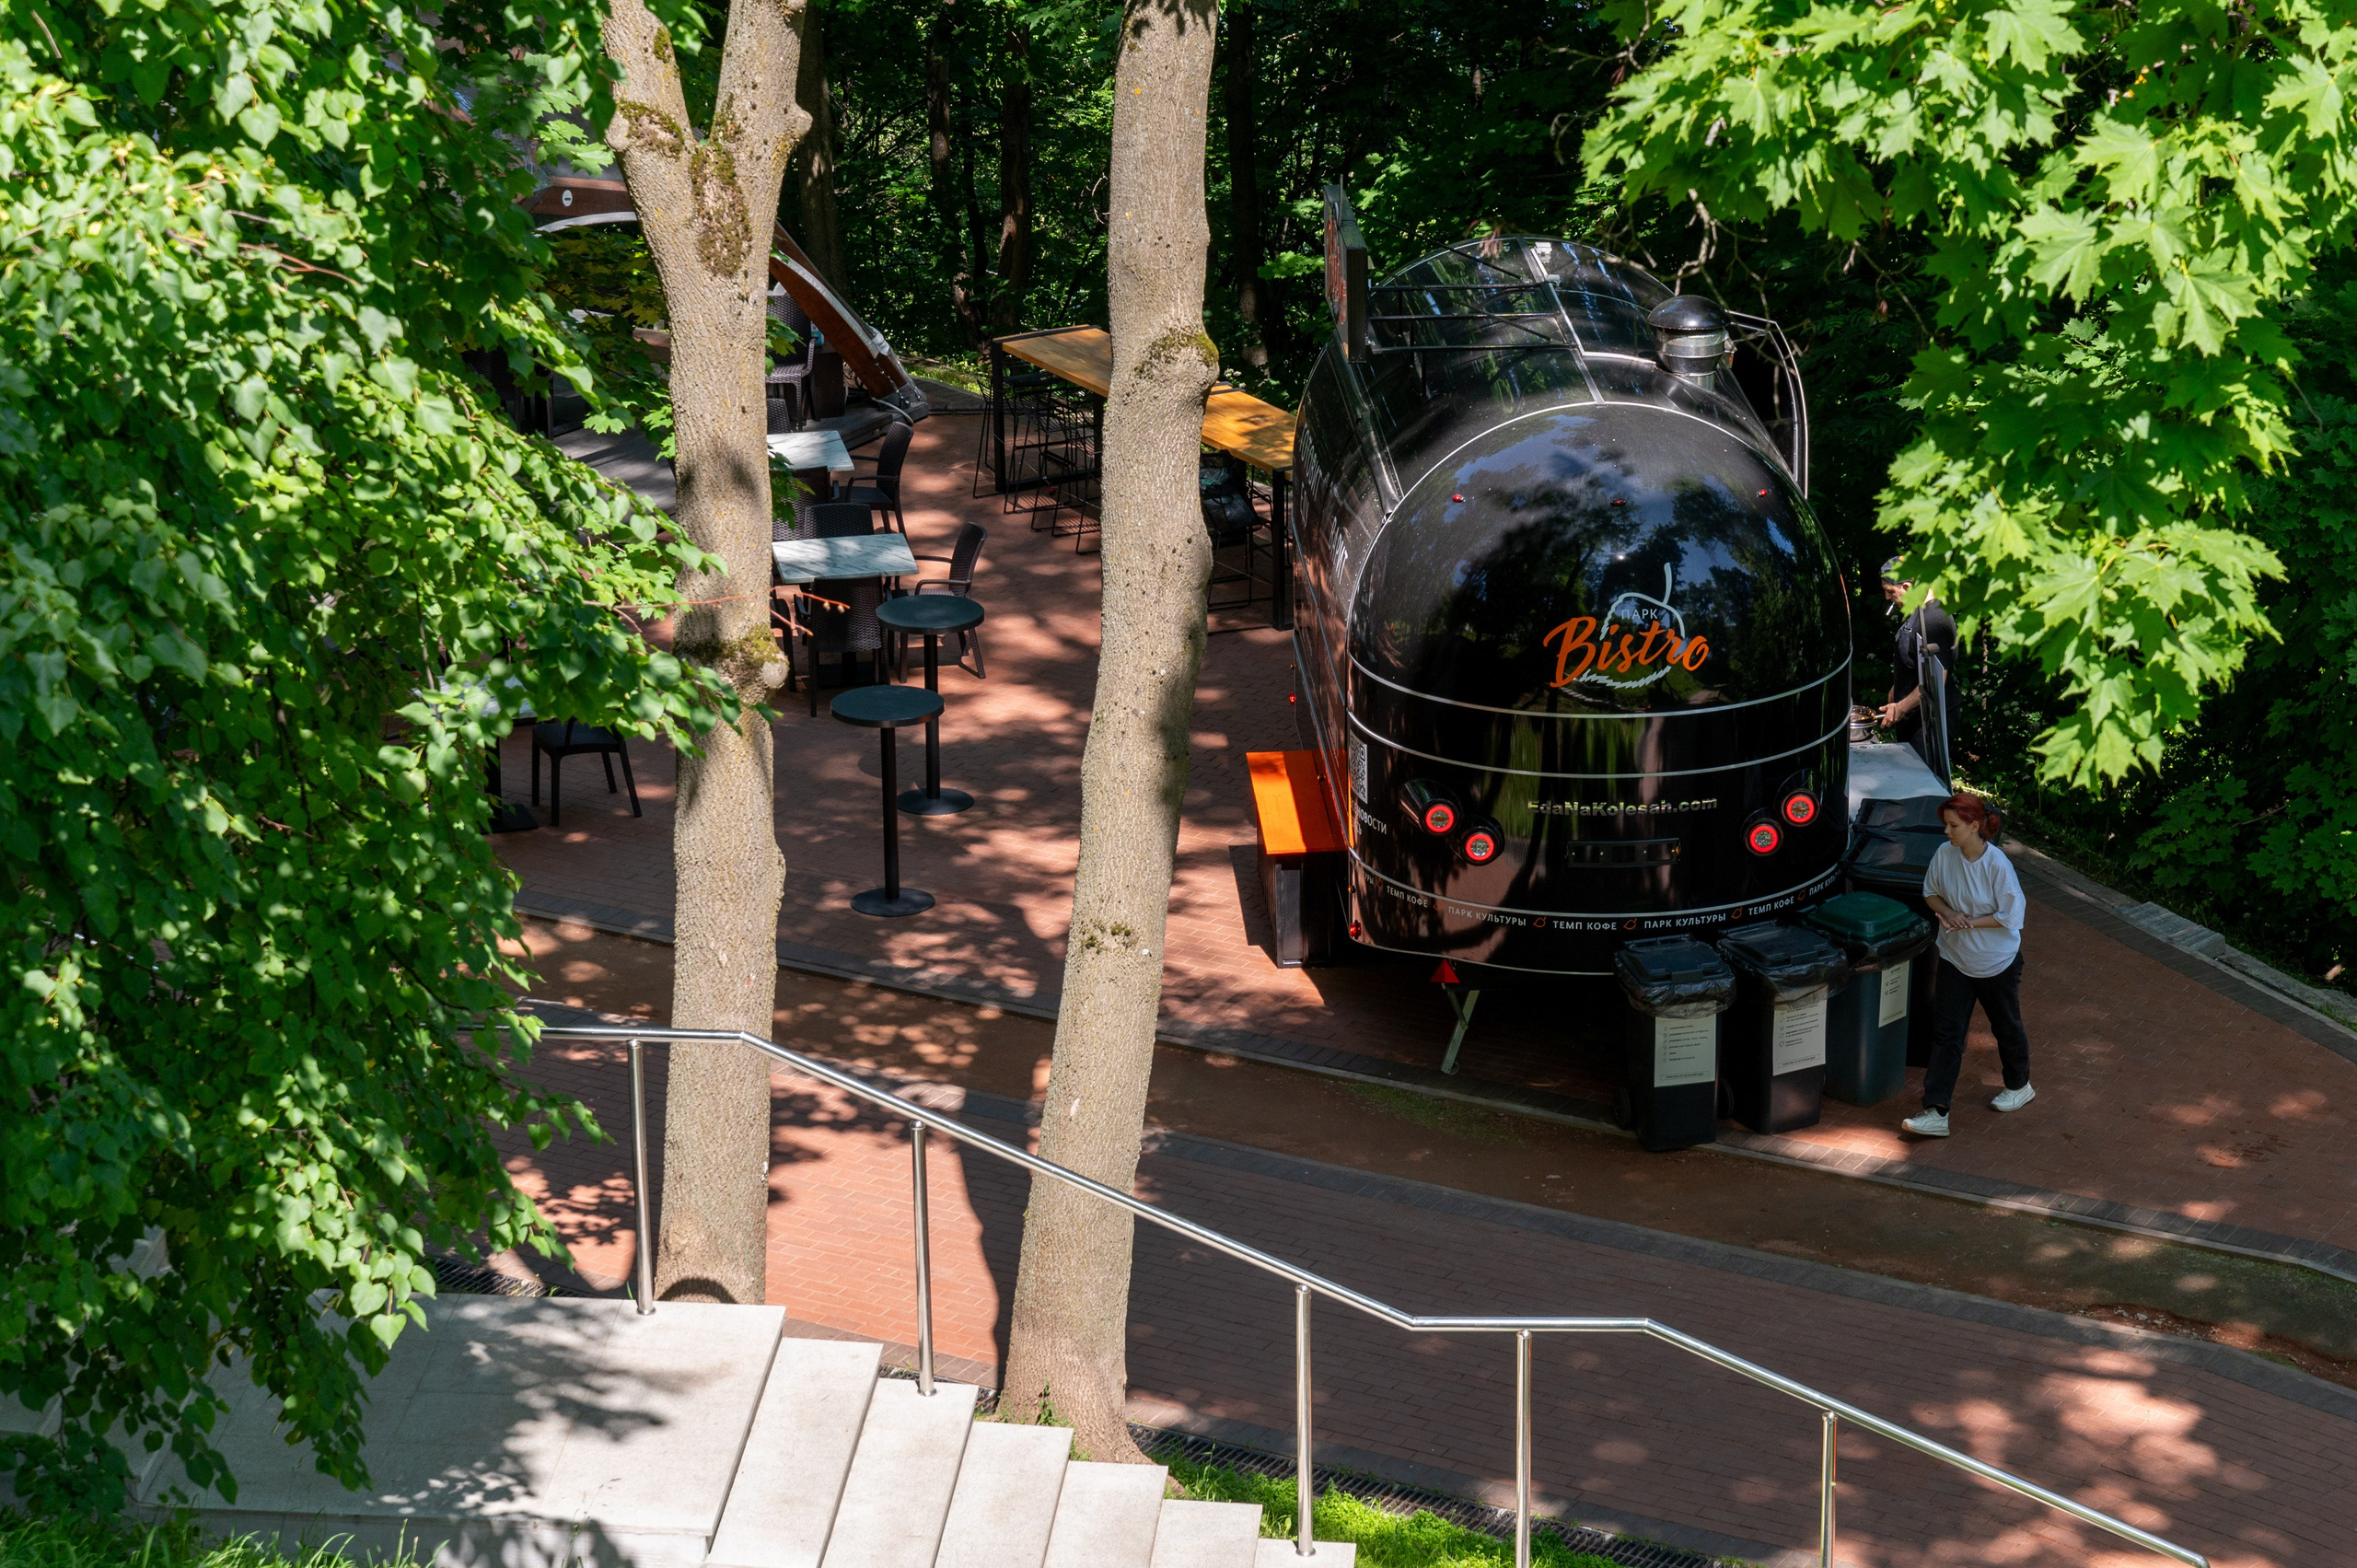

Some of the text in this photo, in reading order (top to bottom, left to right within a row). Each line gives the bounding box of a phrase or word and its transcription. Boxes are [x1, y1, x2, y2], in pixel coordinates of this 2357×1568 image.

[1620, 609, 1658, 621] ПАРК
[1543, 616, 1710, 688] Bistro
[1527, 797, 1718, 818] EdaNaKolesah.com
[1386, 885, 1405, 900] ТЕМП
[1406, 893, 1428, 908] КОФЕ
[1448, 906, 1472, 919] ПАРК
[1475, 912, 1527, 926] КУЛЬТУРЫ
[1552, 920, 1583, 930] ТЕМП
[1586, 921, 1618, 931] КОФЕ
[1643, 919, 1672, 929] ПАРК
[1676, 912, 1726, 927] КУЛЬТУРЫ
[1748, 903, 1771, 916] ТЕМП
[1773, 895, 1794, 911] КОФЕ
